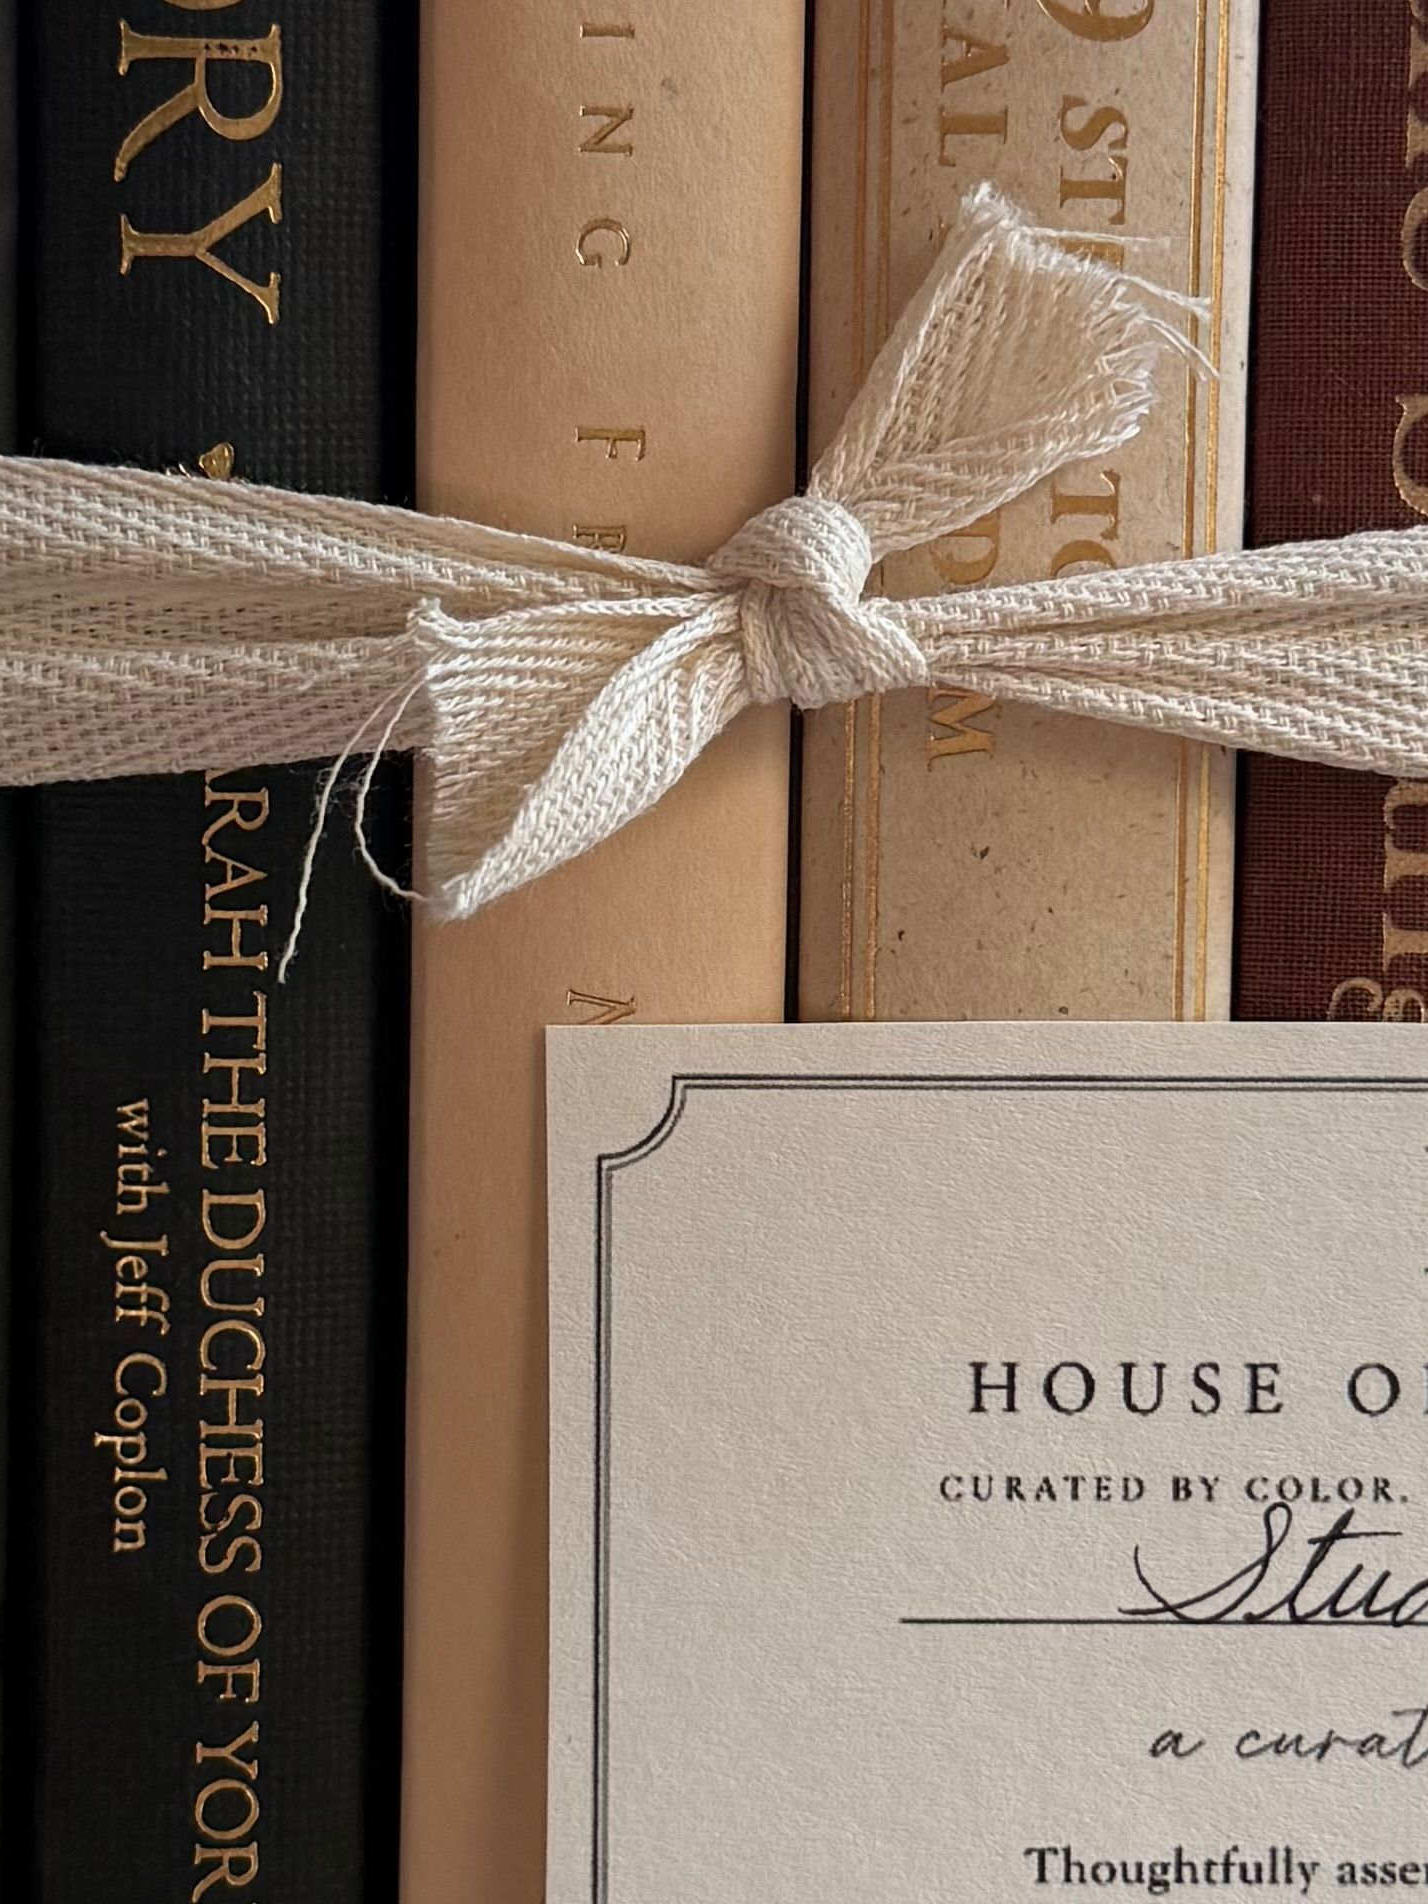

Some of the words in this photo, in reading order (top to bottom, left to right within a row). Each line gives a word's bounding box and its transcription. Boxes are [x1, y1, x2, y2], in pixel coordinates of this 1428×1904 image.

[202, 768, 269, 971] RAH
[201, 991, 267, 1169] THE
[117, 1099, 169, 1214] with
[100, 1231, 170, 1335] Jeff
[199, 1189, 266, 1573] DUCHESS
[969, 1361, 1283, 1416] HOUSE
[94, 1353, 167, 1552] Coplon
[940, 1475, 1145, 1502] CURATED
[1172, 1476, 1219, 1502] BY
[197, 1595, 262, 1704] OF
[1149, 1730, 1205, 1759] a
[1023, 1844, 1320, 1895] Thoughtfully
